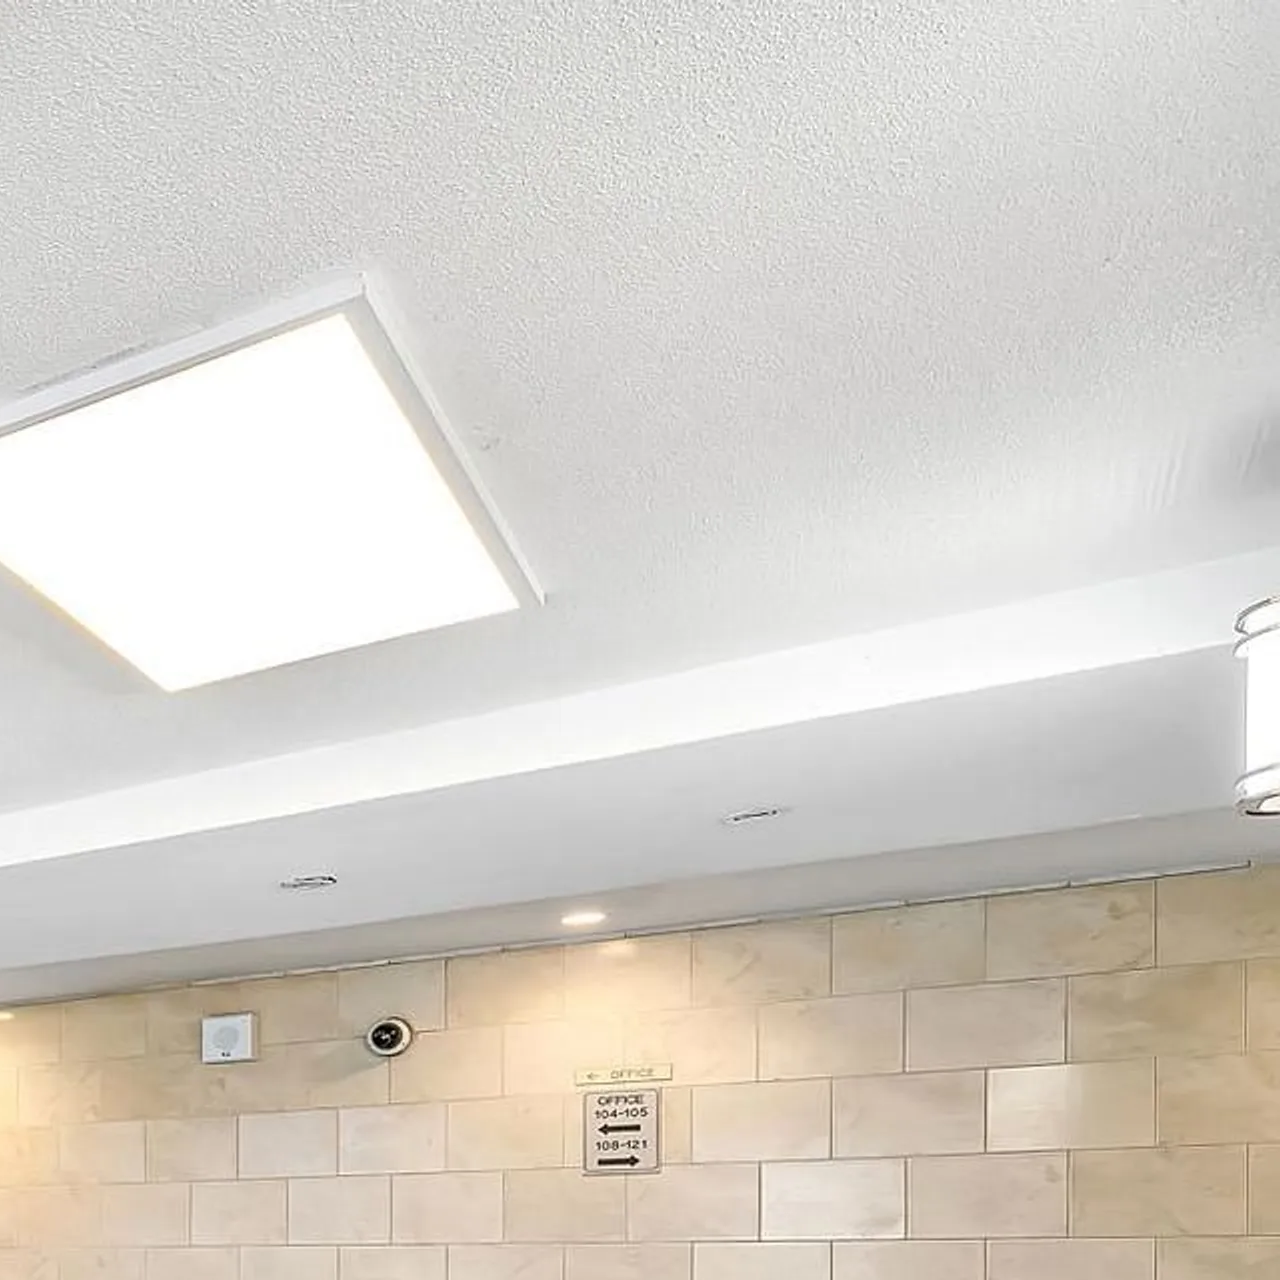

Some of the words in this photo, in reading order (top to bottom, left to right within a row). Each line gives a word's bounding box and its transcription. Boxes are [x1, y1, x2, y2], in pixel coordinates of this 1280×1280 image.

[610, 1067, 654, 1079] OFFICE
[597, 1094, 645, 1106] OFFICE
[594, 1106, 649, 1119] 104-105
[595, 1139, 648, 1151] 108-121
